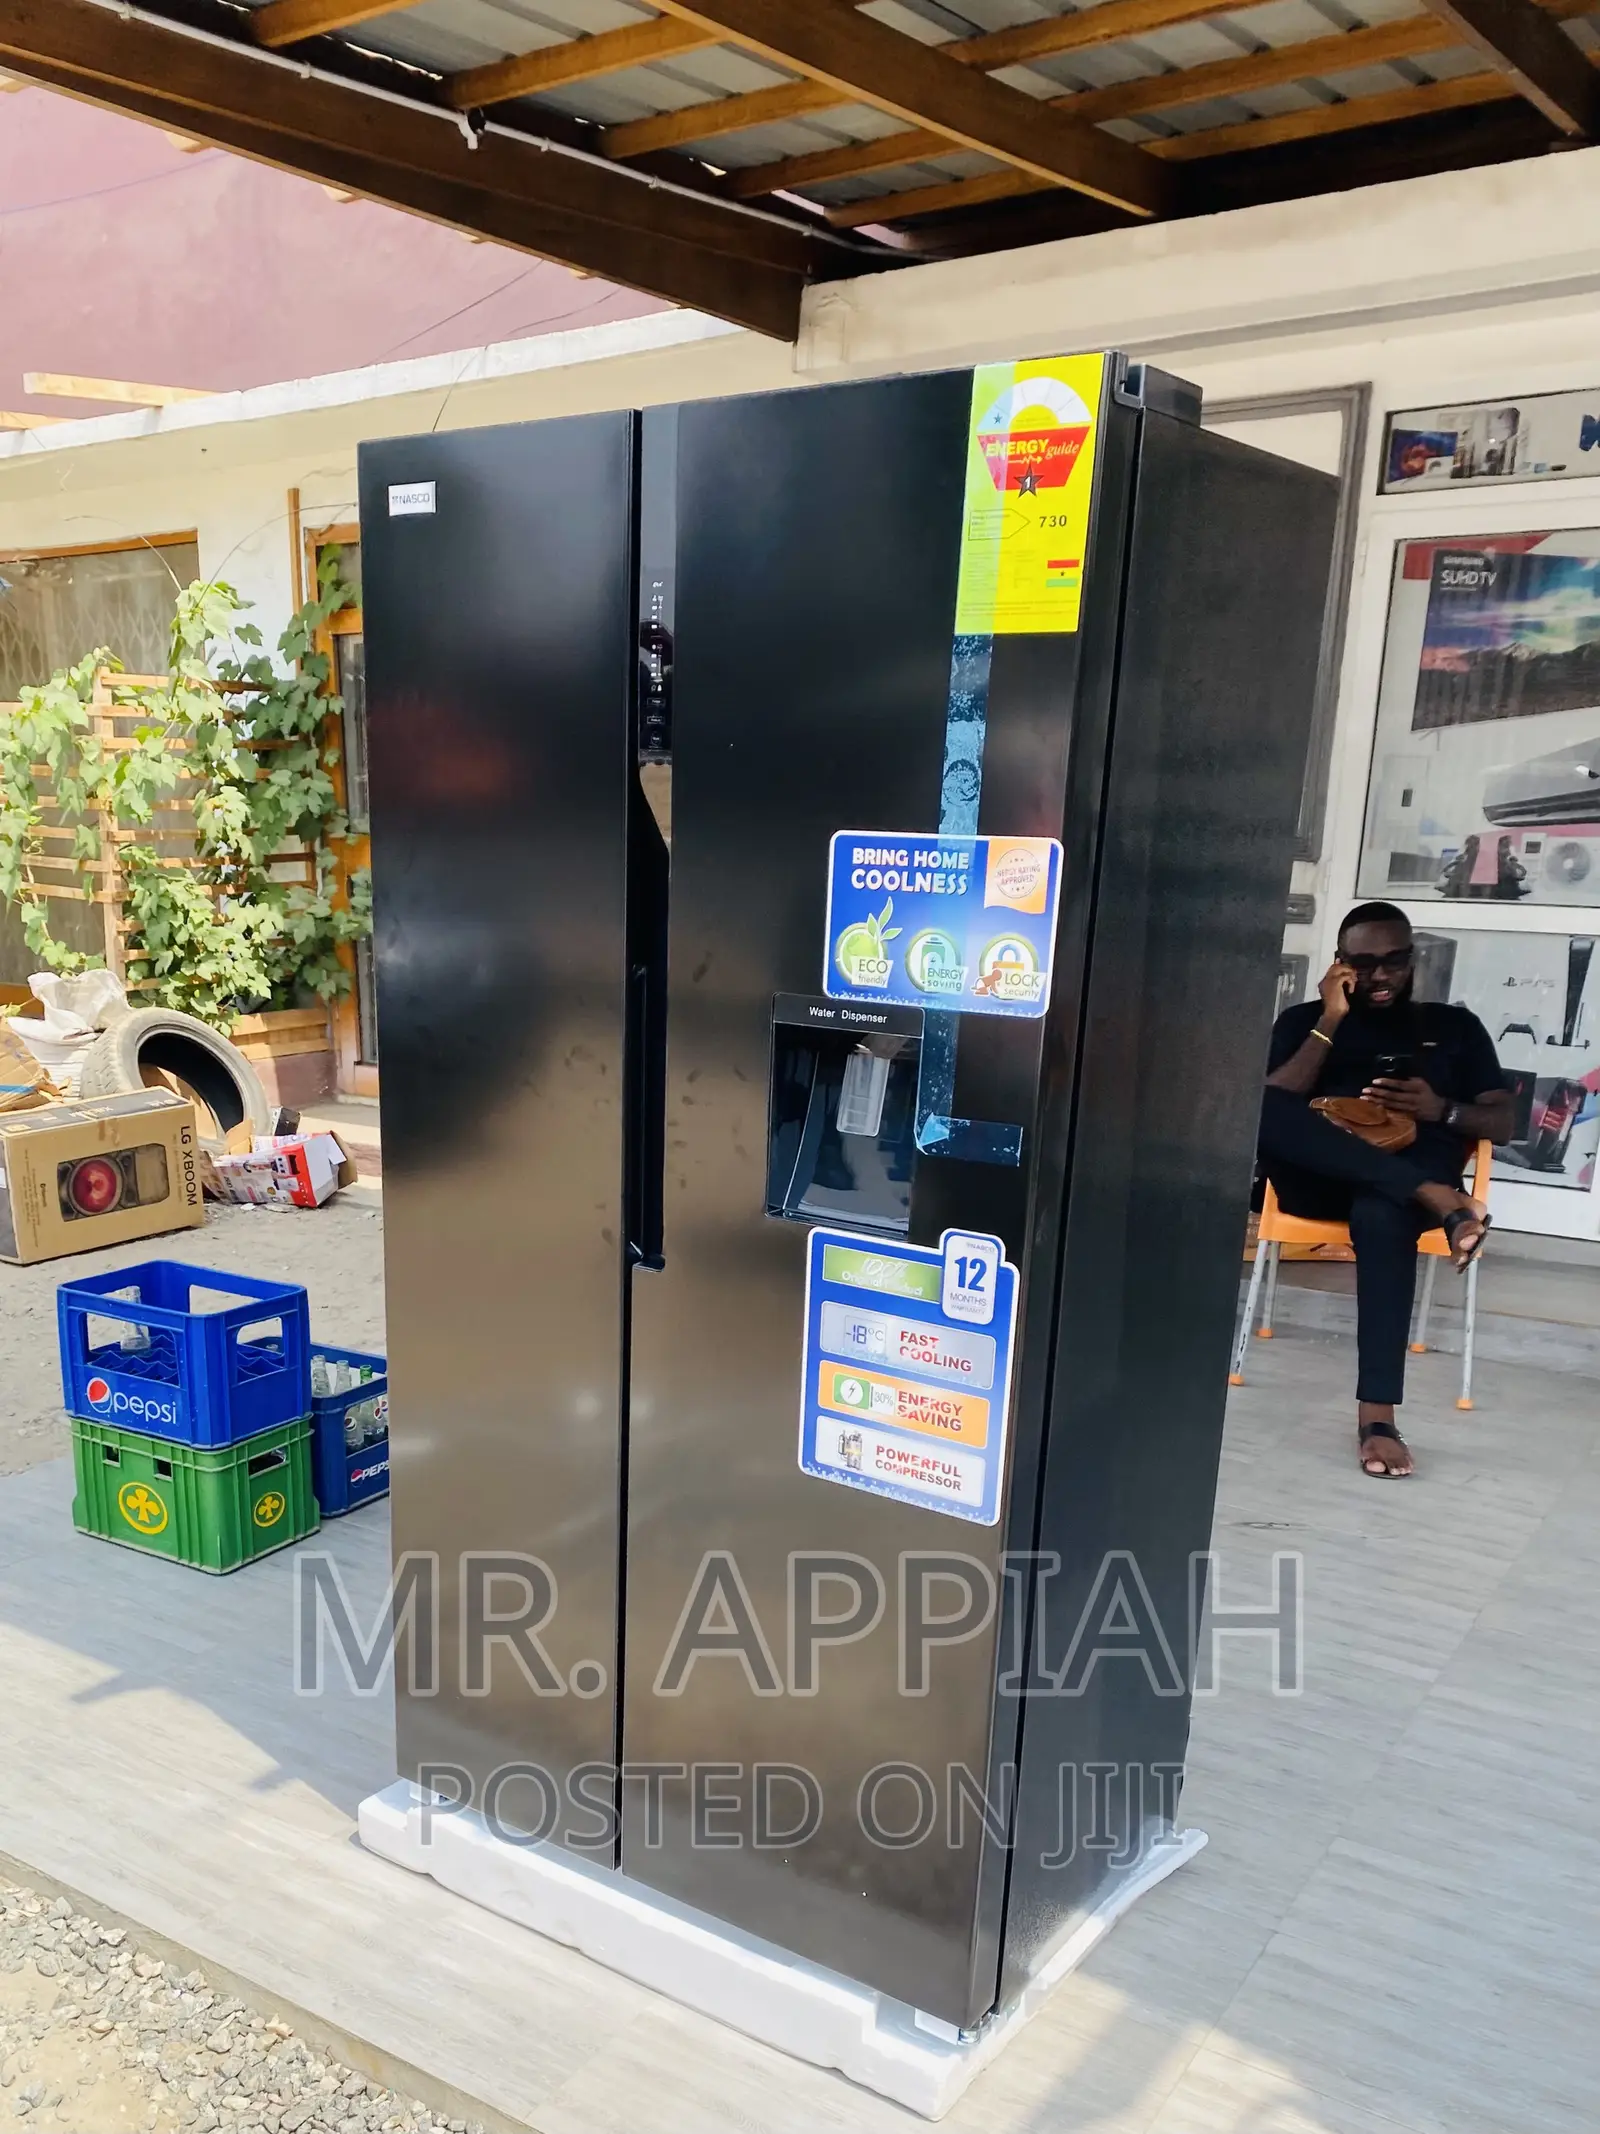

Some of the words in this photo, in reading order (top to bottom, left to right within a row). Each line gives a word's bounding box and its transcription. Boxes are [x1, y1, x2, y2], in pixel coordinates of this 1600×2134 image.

[985, 439, 1049, 458] ENERGY
[1045, 440, 1080, 460] guide
[1024, 476, 1031, 489] 1
[400, 493, 430, 504] NASCO
[1038, 514, 1067, 528] 730
[852, 847, 909, 867] BRING
[913, 850, 970, 870] HOME
[851, 869, 968, 896] COOLNESS
[858, 958, 888, 974] ECO
[927, 967, 964, 980] ENERGY
[857, 975, 887, 988] friendly
[927, 980, 962, 992] saving
[1004, 973, 1040, 988] LOCK
[809, 1006, 836, 1018] Water
[841, 1009, 888, 1024] Dispenser
[180, 1125, 192, 1145] LG
[182, 1150, 198, 1206] XBOOM
[954, 1256, 987, 1292] 12
[950, 1292, 987, 1307] MONTHS
[900, 1330, 940, 1349] FAST
[899, 1345, 972, 1372] COOLING
[111, 1390, 177, 1425] pepsi
[874, 1391, 894, 1407] 30%
[898, 1390, 963, 1416] ENERGY
[897, 1404, 962, 1432] SAVING
[361, 1460, 390, 1481] PEPS
[876, 1445, 962, 1478] POWERFUL
[875, 1459, 961, 1491] COMPRESSOR
